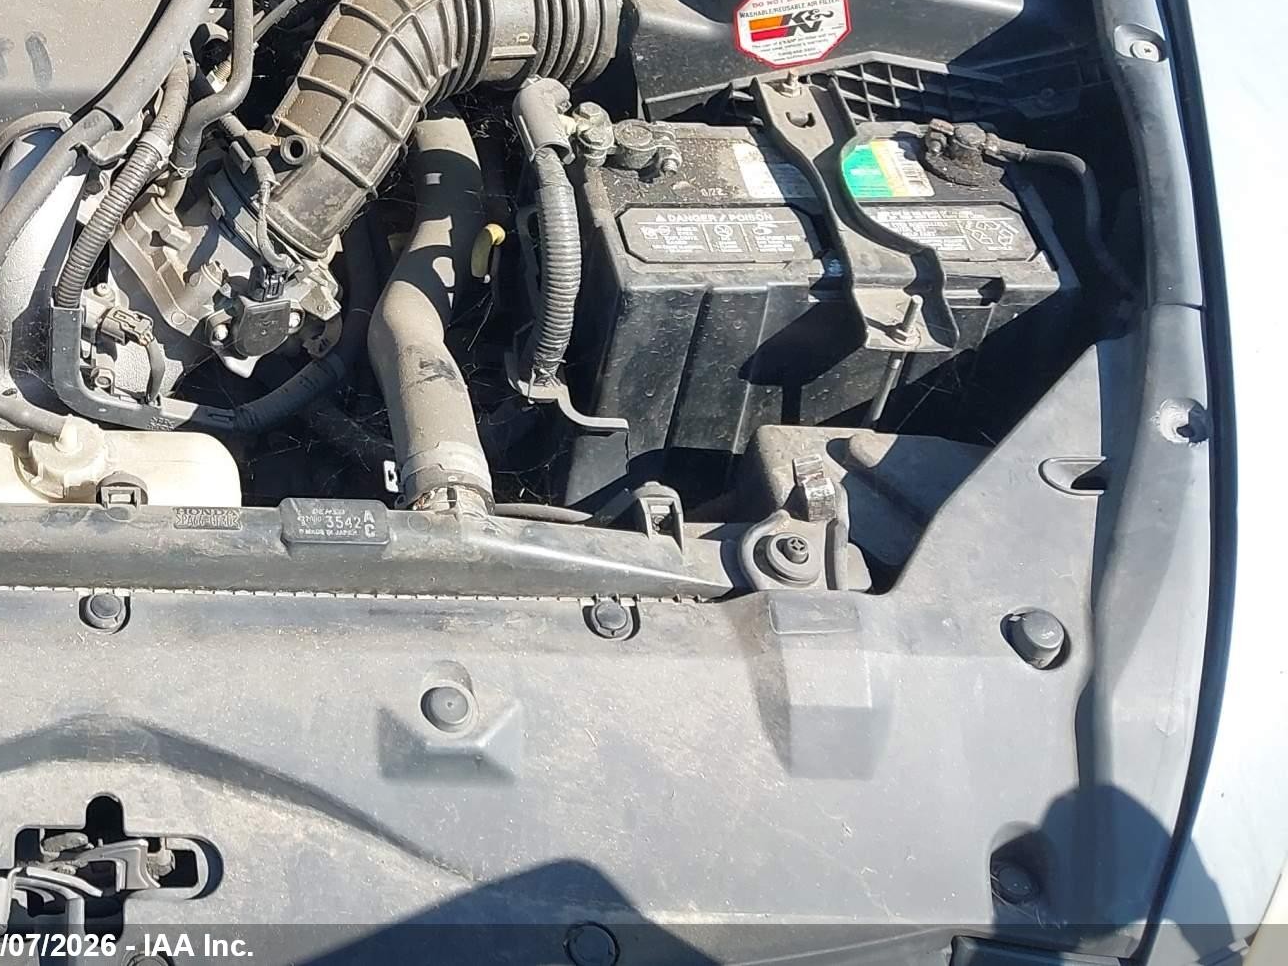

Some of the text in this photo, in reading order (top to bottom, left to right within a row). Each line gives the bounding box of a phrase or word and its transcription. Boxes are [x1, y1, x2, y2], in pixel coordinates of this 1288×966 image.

[752, 0, 764, 9] DO
[806, 0, 818, 7] AIR
[667, 213, 717, 222] DANGER
[728, 212, 774, 222] POISON
[173, 507, 238, 516] HONDA
[325, 515, 362, 529] 3542
